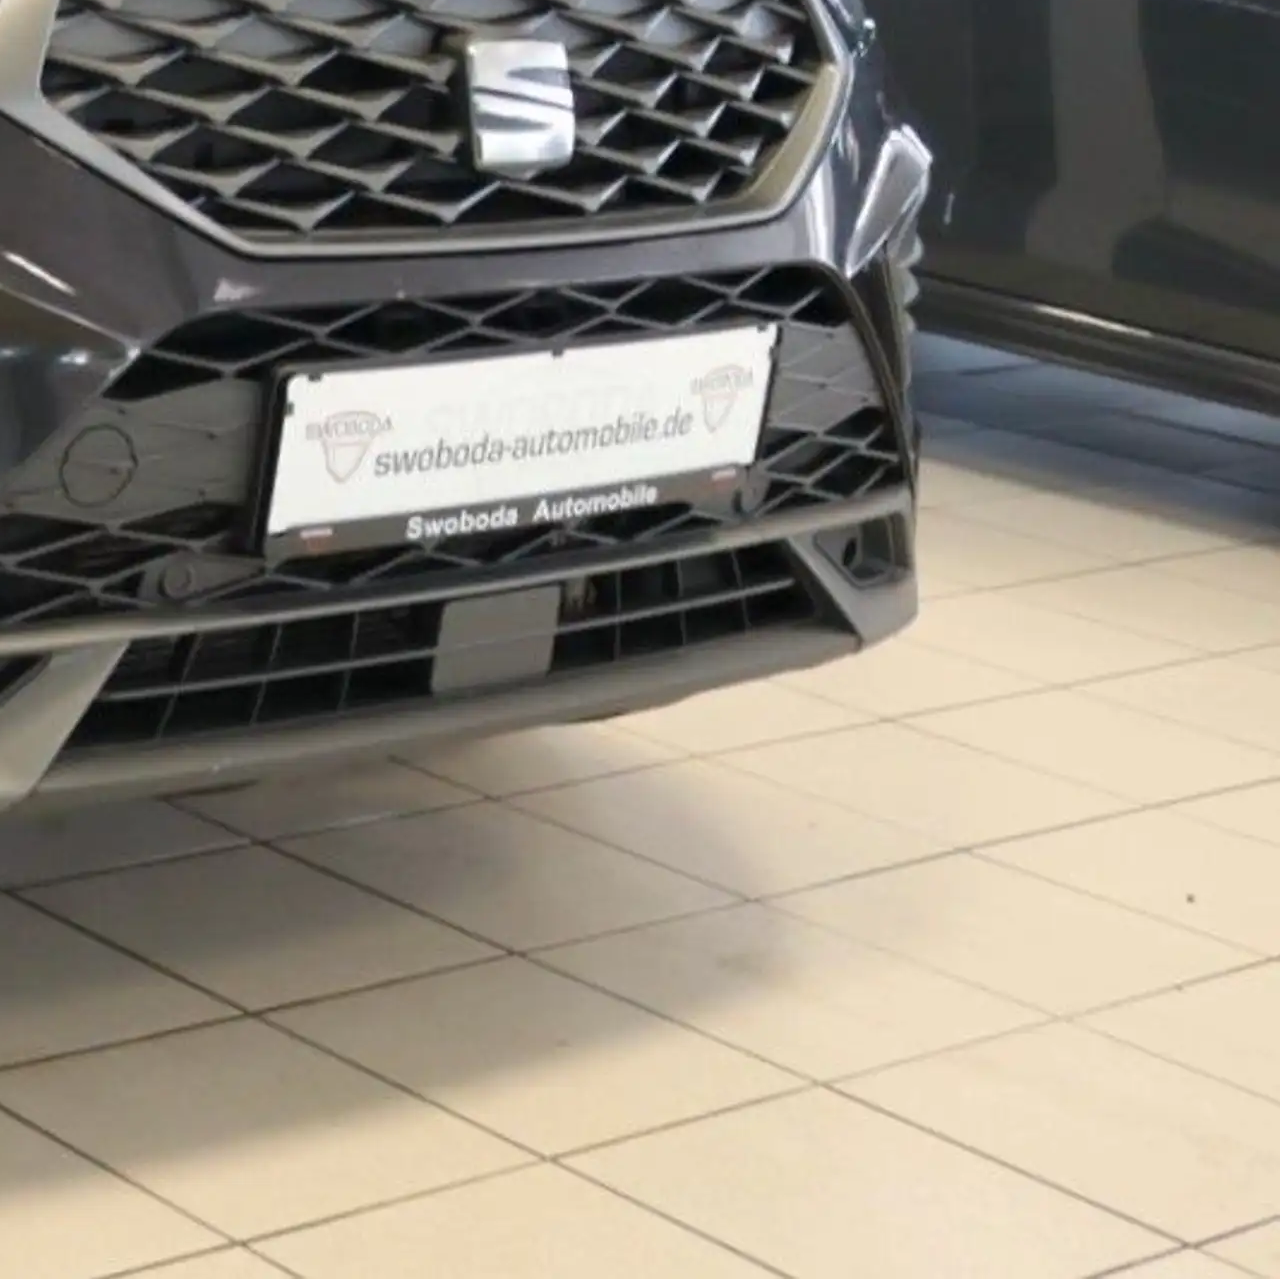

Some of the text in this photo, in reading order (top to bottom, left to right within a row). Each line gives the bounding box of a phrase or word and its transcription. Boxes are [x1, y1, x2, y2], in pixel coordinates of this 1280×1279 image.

[374, 407, 693, 476] swoboda-automobile.de
[406, 478, 658, 540] Swoboda Automobile
